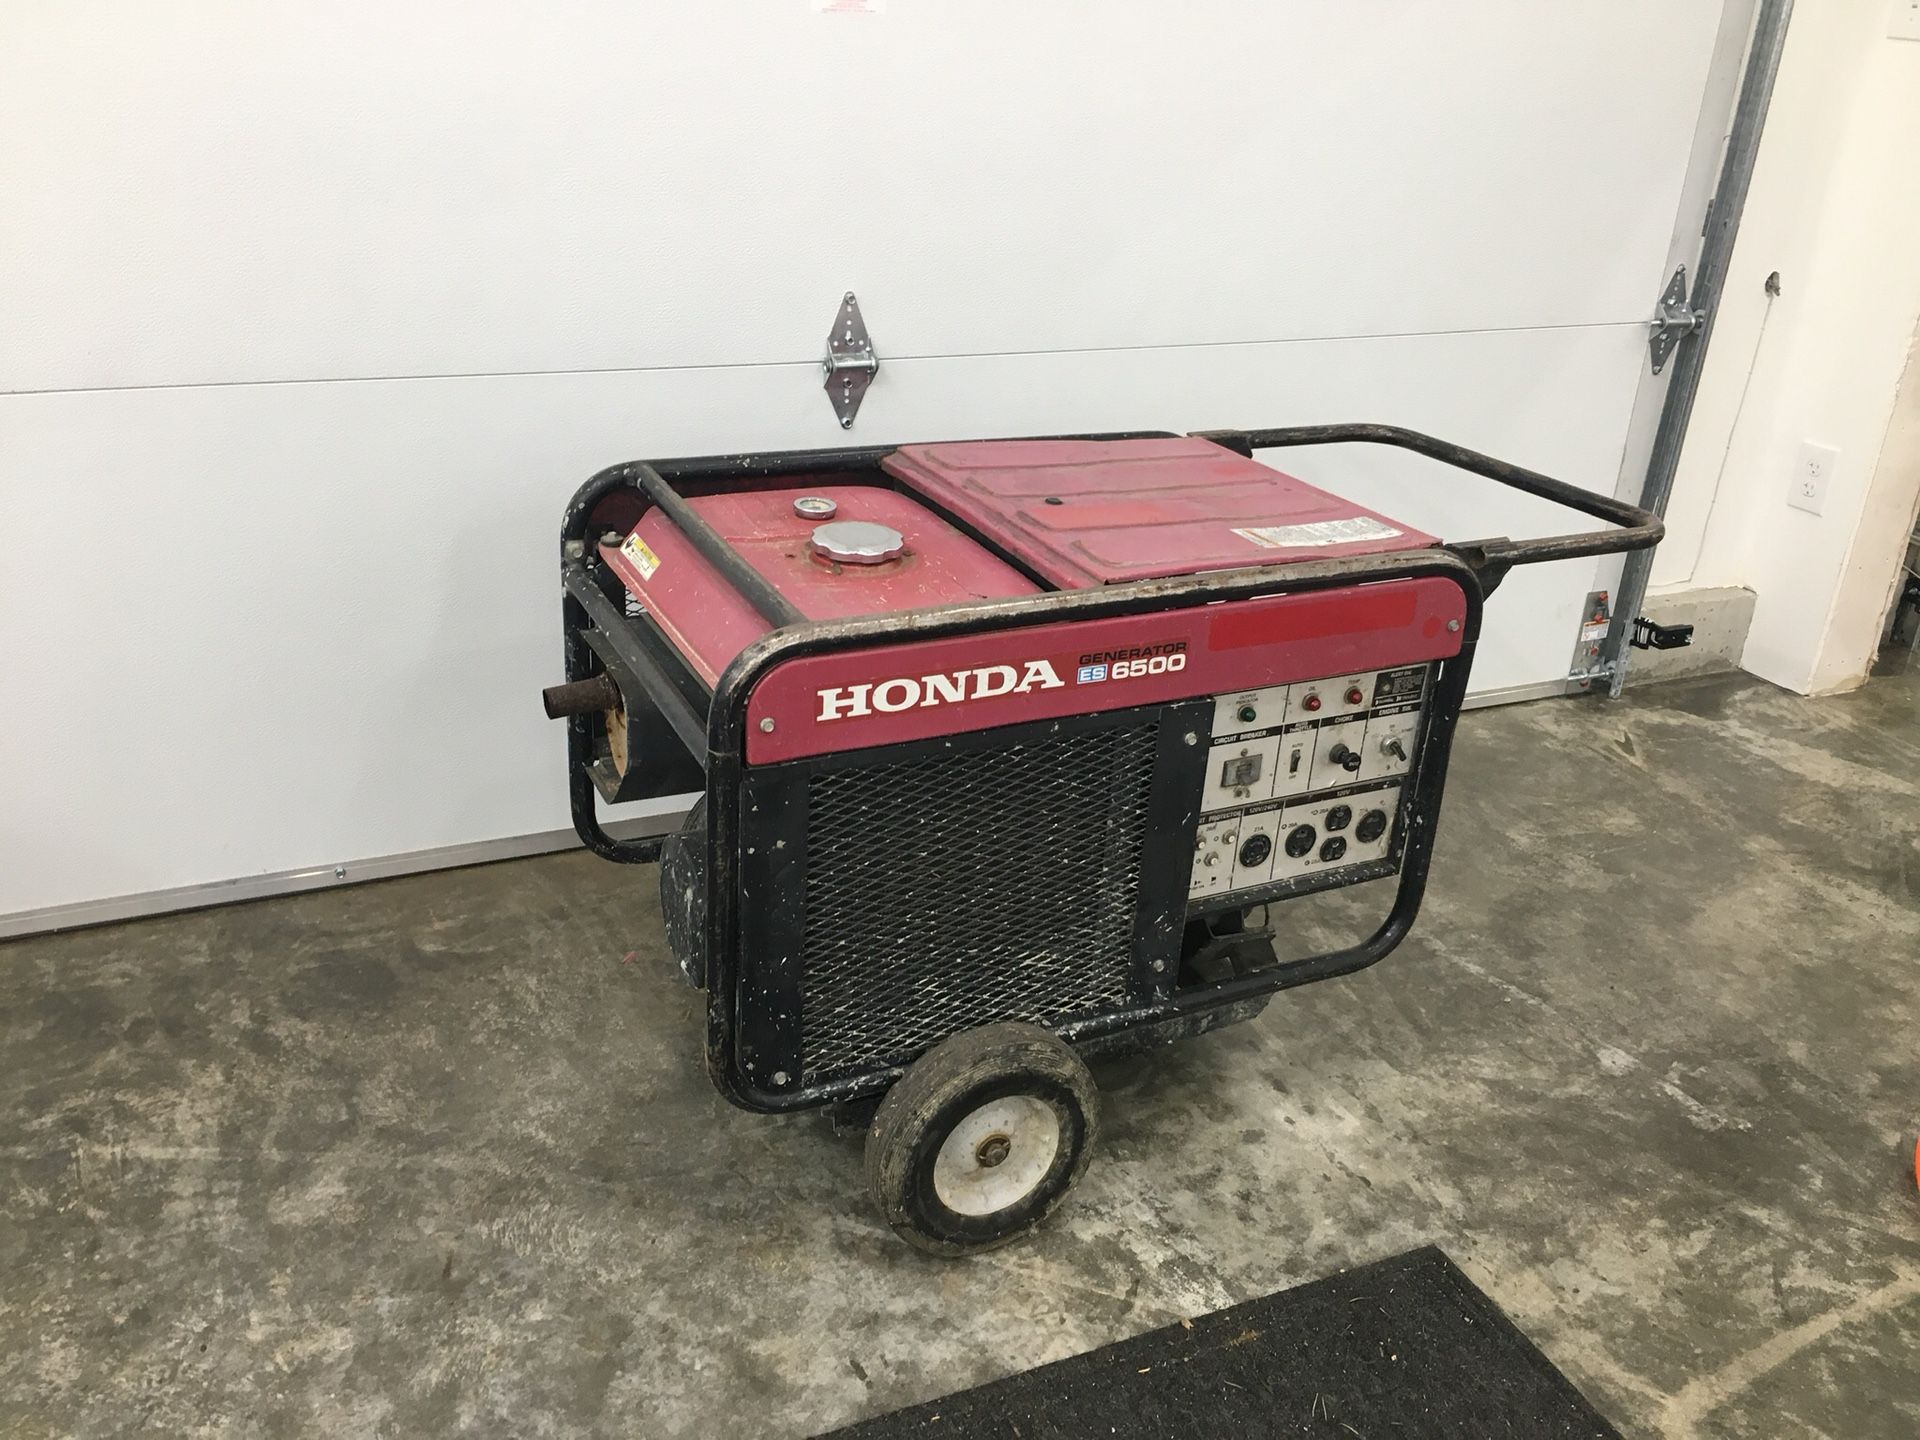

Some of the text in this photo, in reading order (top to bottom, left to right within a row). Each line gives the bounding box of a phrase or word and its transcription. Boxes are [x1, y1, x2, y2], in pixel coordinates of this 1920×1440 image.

[1079, 641, 1188, 666] GENERATOR
[1080, 653, 1186, 682] ES 6500
[815, 660, 1065, 722] HONDA
[1214, 735, 1237, 745] CIRCUIT
